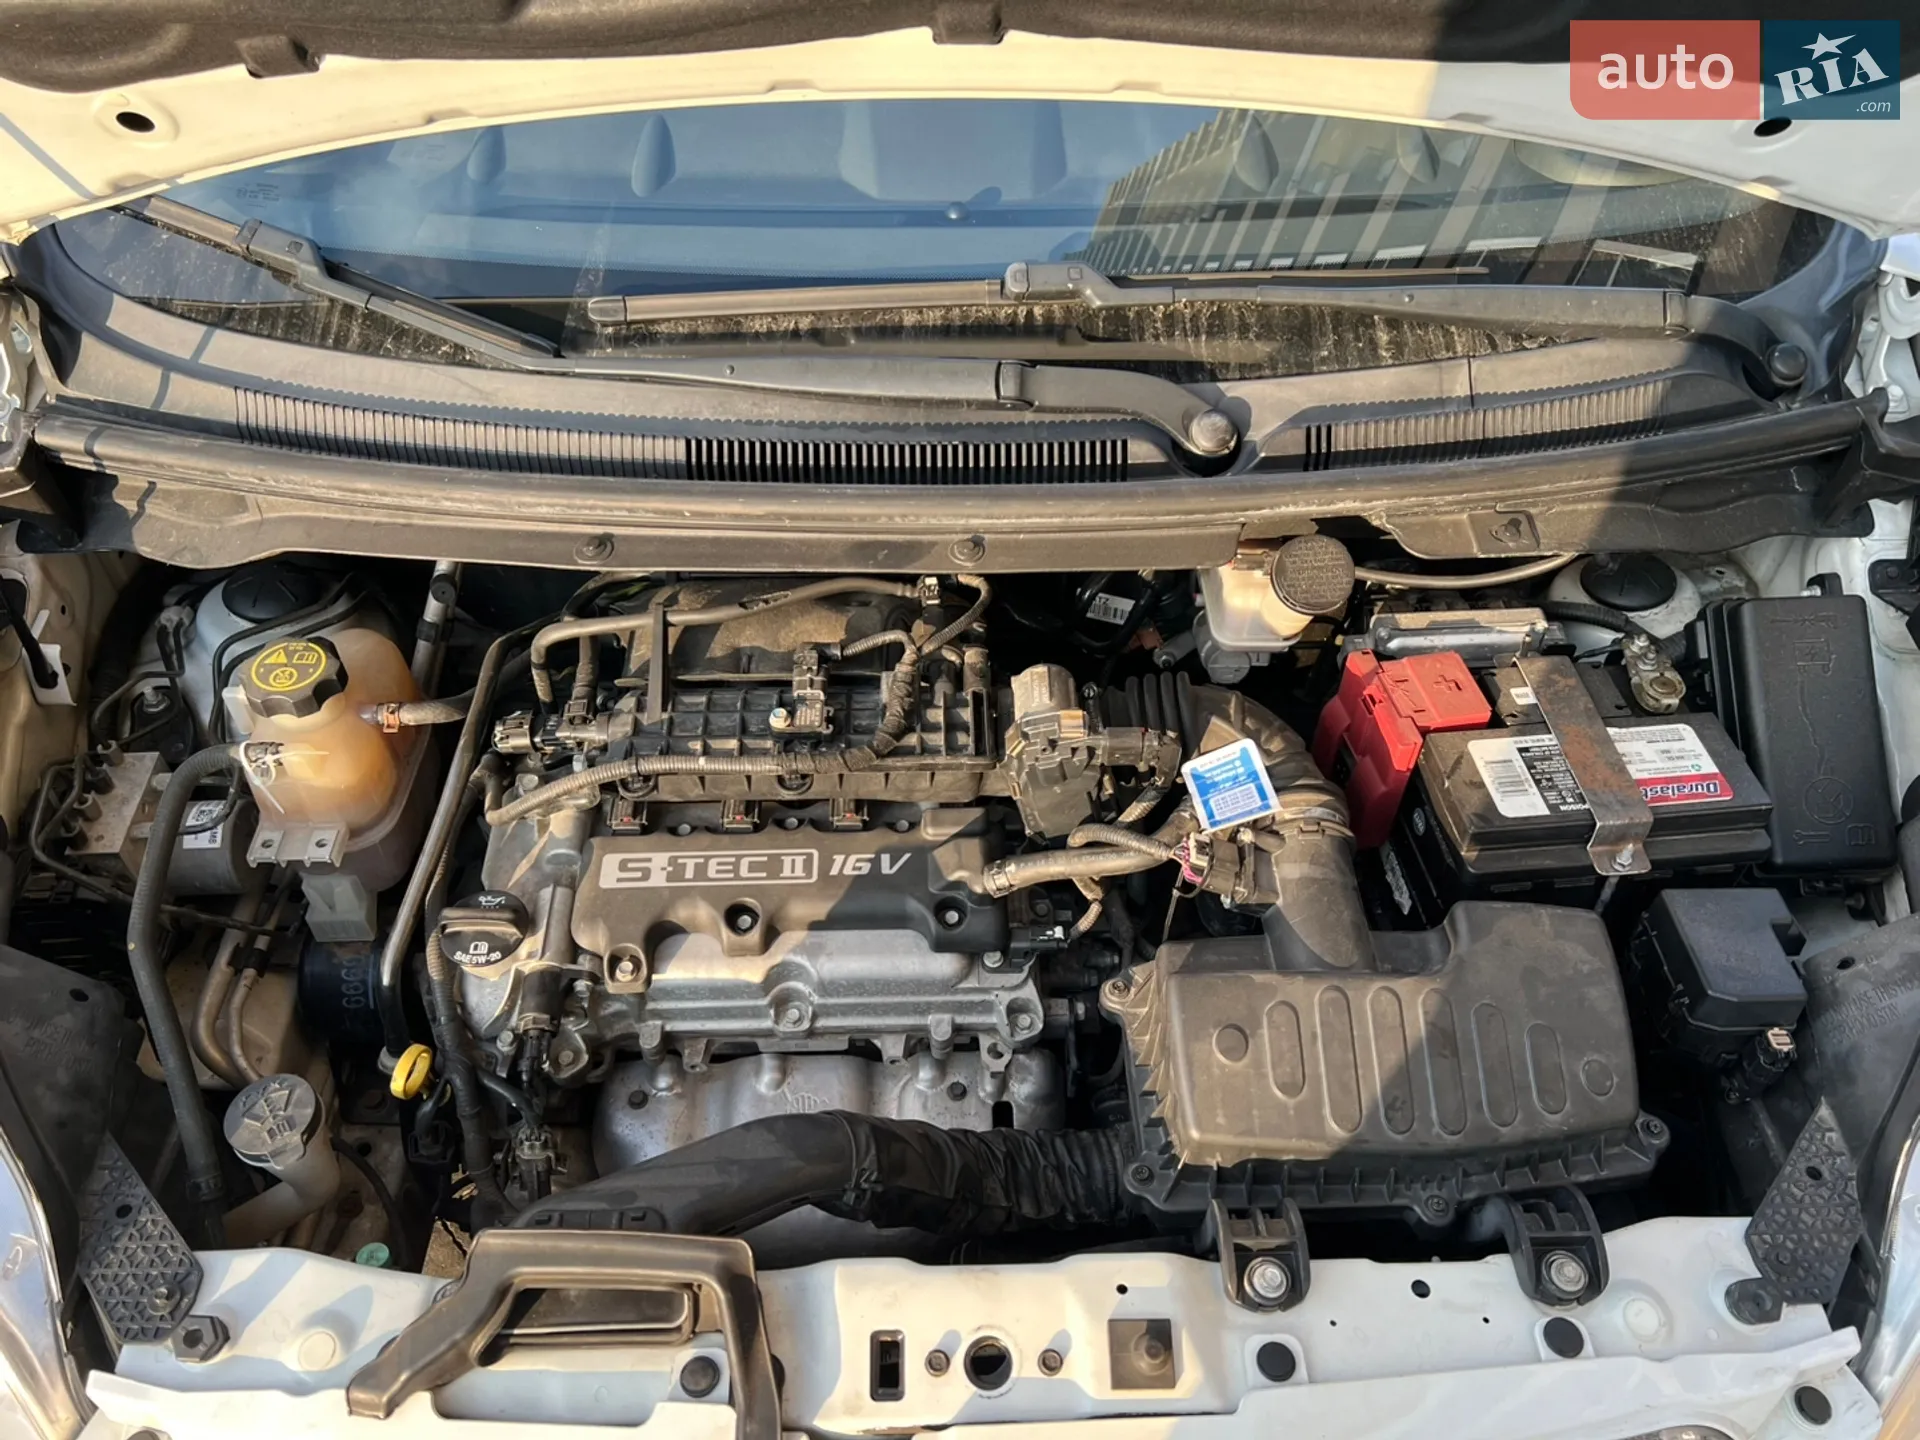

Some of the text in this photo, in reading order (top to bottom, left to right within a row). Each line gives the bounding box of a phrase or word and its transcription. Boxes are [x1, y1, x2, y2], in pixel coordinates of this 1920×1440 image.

[1640, 780, 1720, 799] Duralast
[453, 950, 502, 964] SAE 5W-20
